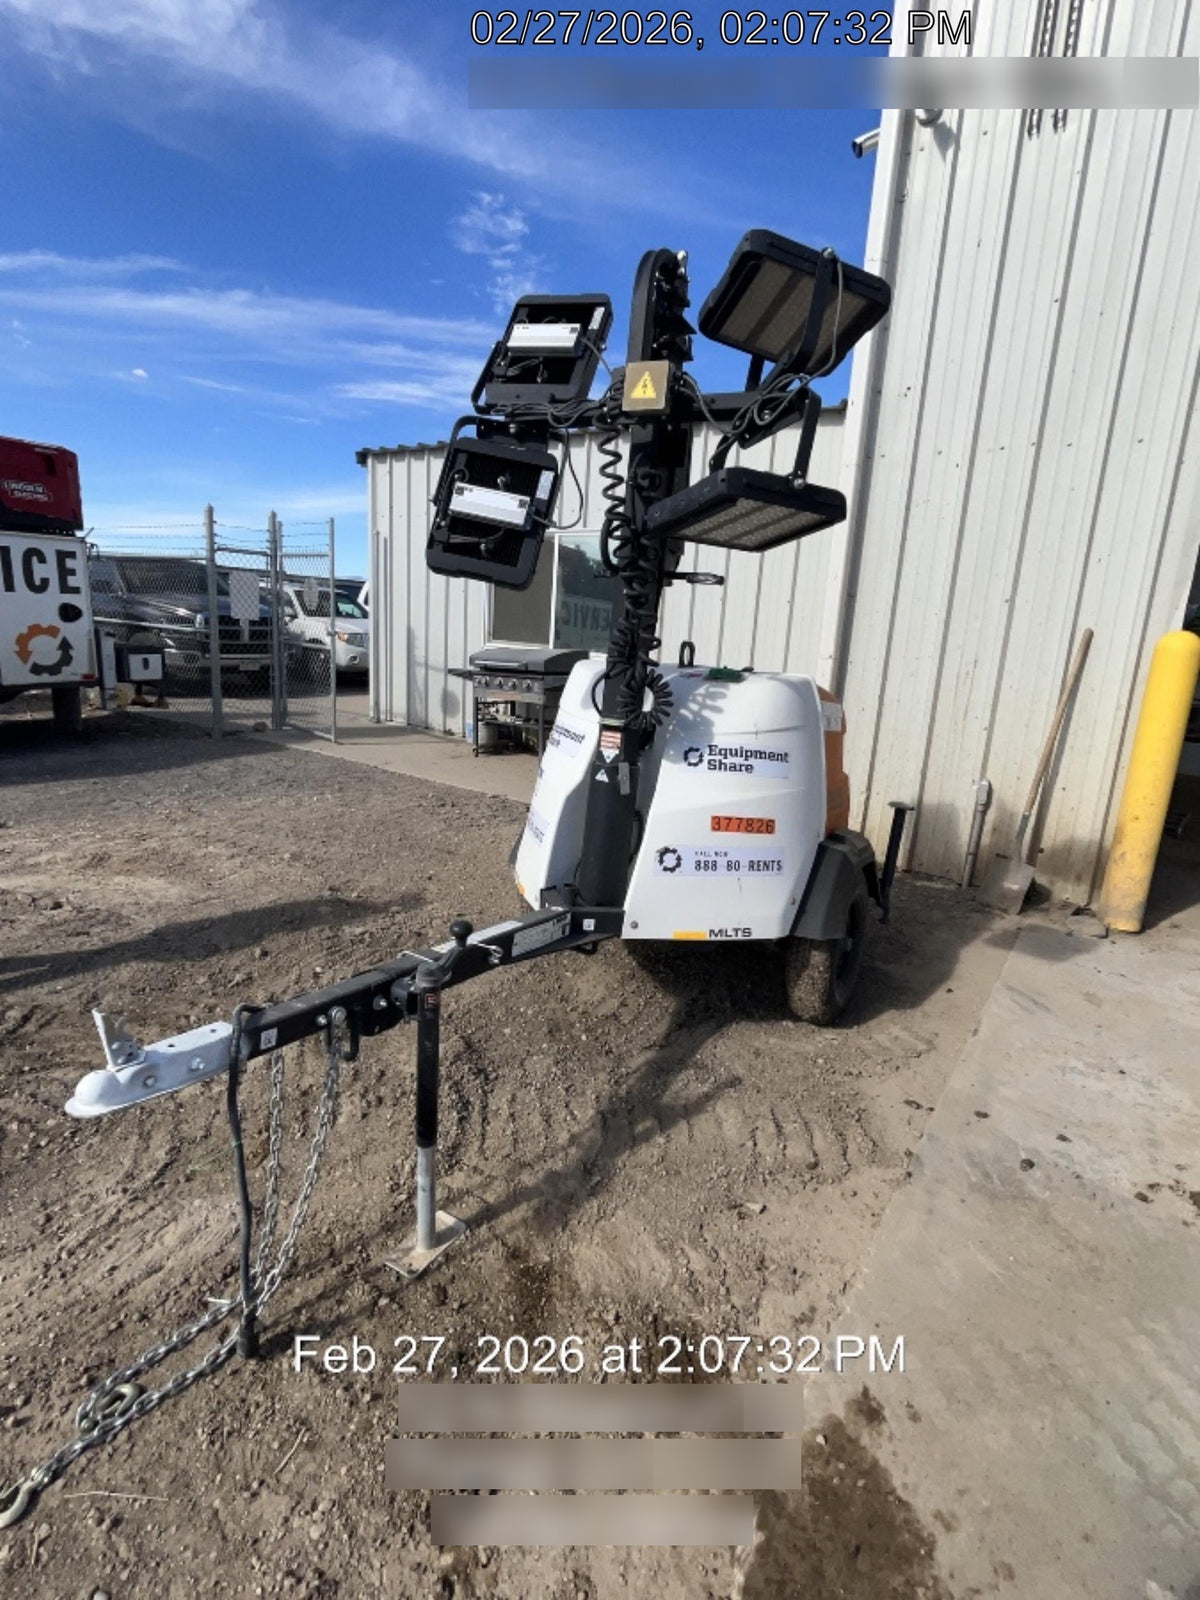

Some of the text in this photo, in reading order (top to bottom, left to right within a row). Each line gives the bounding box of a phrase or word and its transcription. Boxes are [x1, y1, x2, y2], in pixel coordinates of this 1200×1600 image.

[707, 744, 790, 763] Equipment
[707, 758, 754, 774] Share
[712, 816, 775, 834] 377826
[708, 927, 752, 938] MLTS
